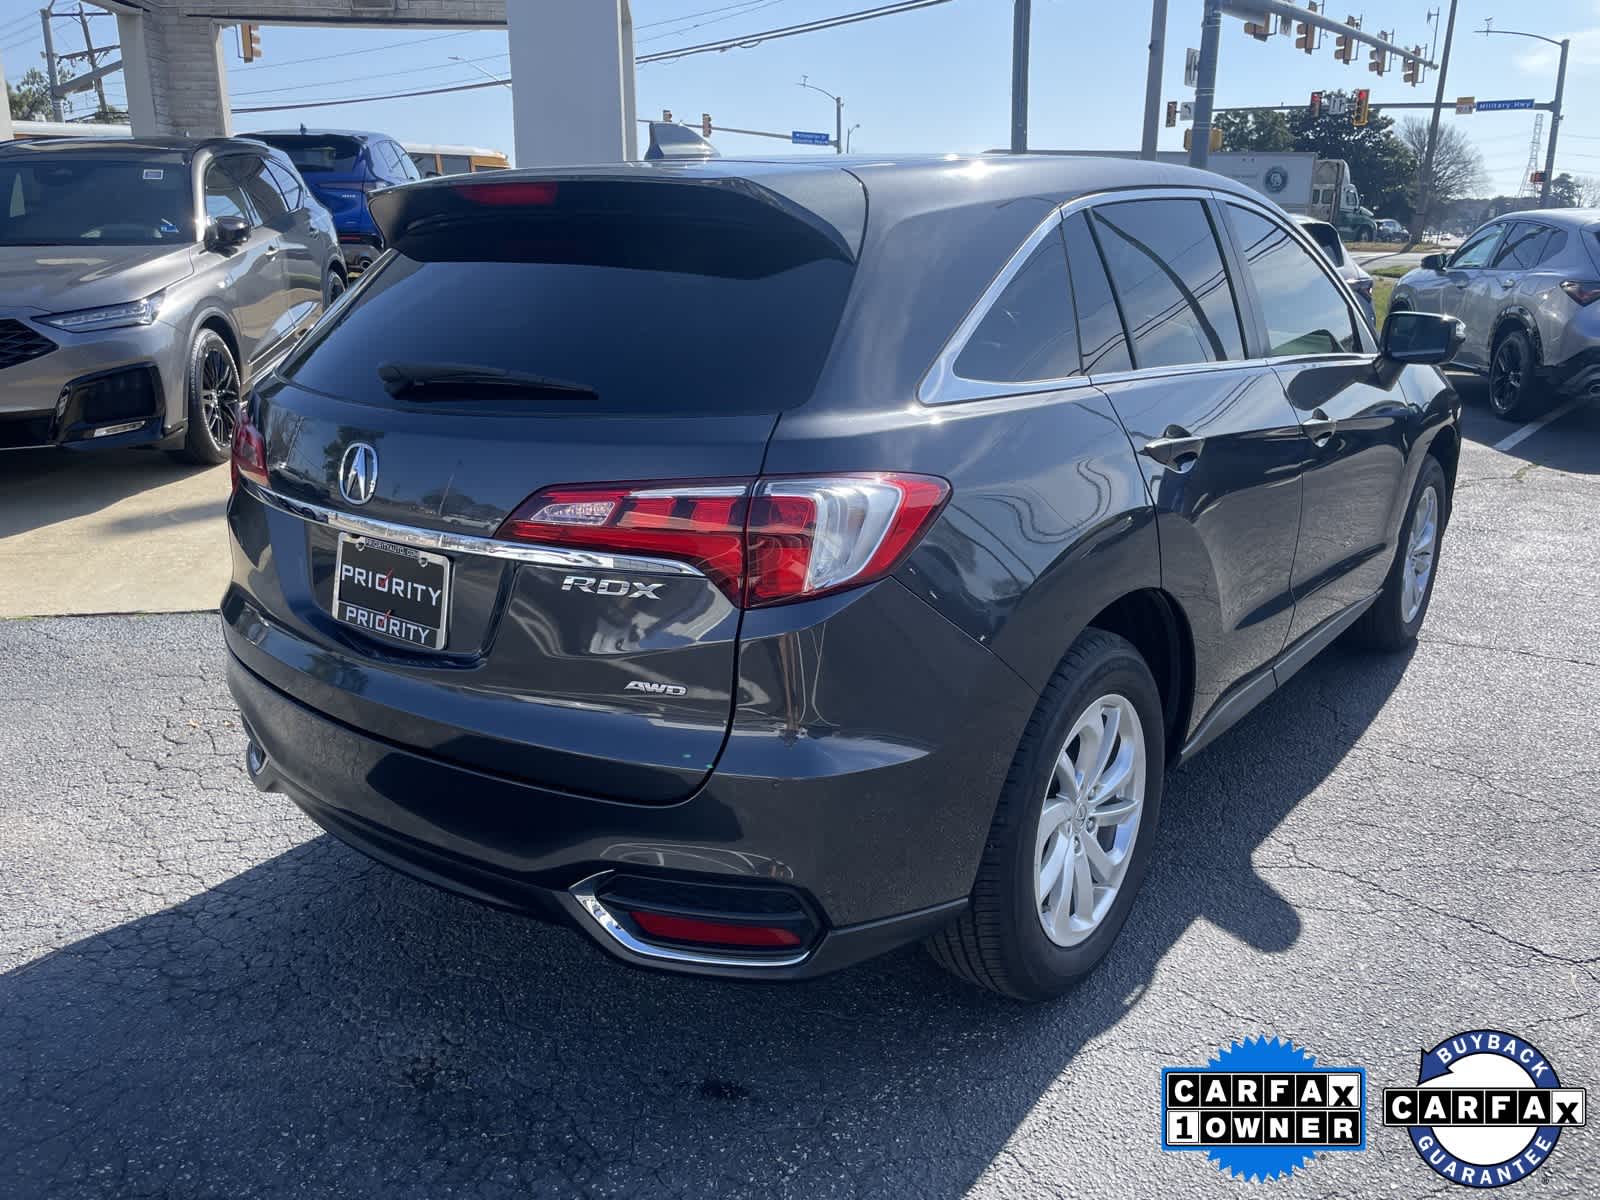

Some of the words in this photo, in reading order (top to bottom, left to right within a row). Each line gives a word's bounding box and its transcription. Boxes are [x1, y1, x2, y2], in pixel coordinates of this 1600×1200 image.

[341, 564, 442, 607] PRIORITY
[561, 575, 666, 600] RDX
[345, 606, 430, 644] PRIORITY
[624, 680, 688, 696] AWD
